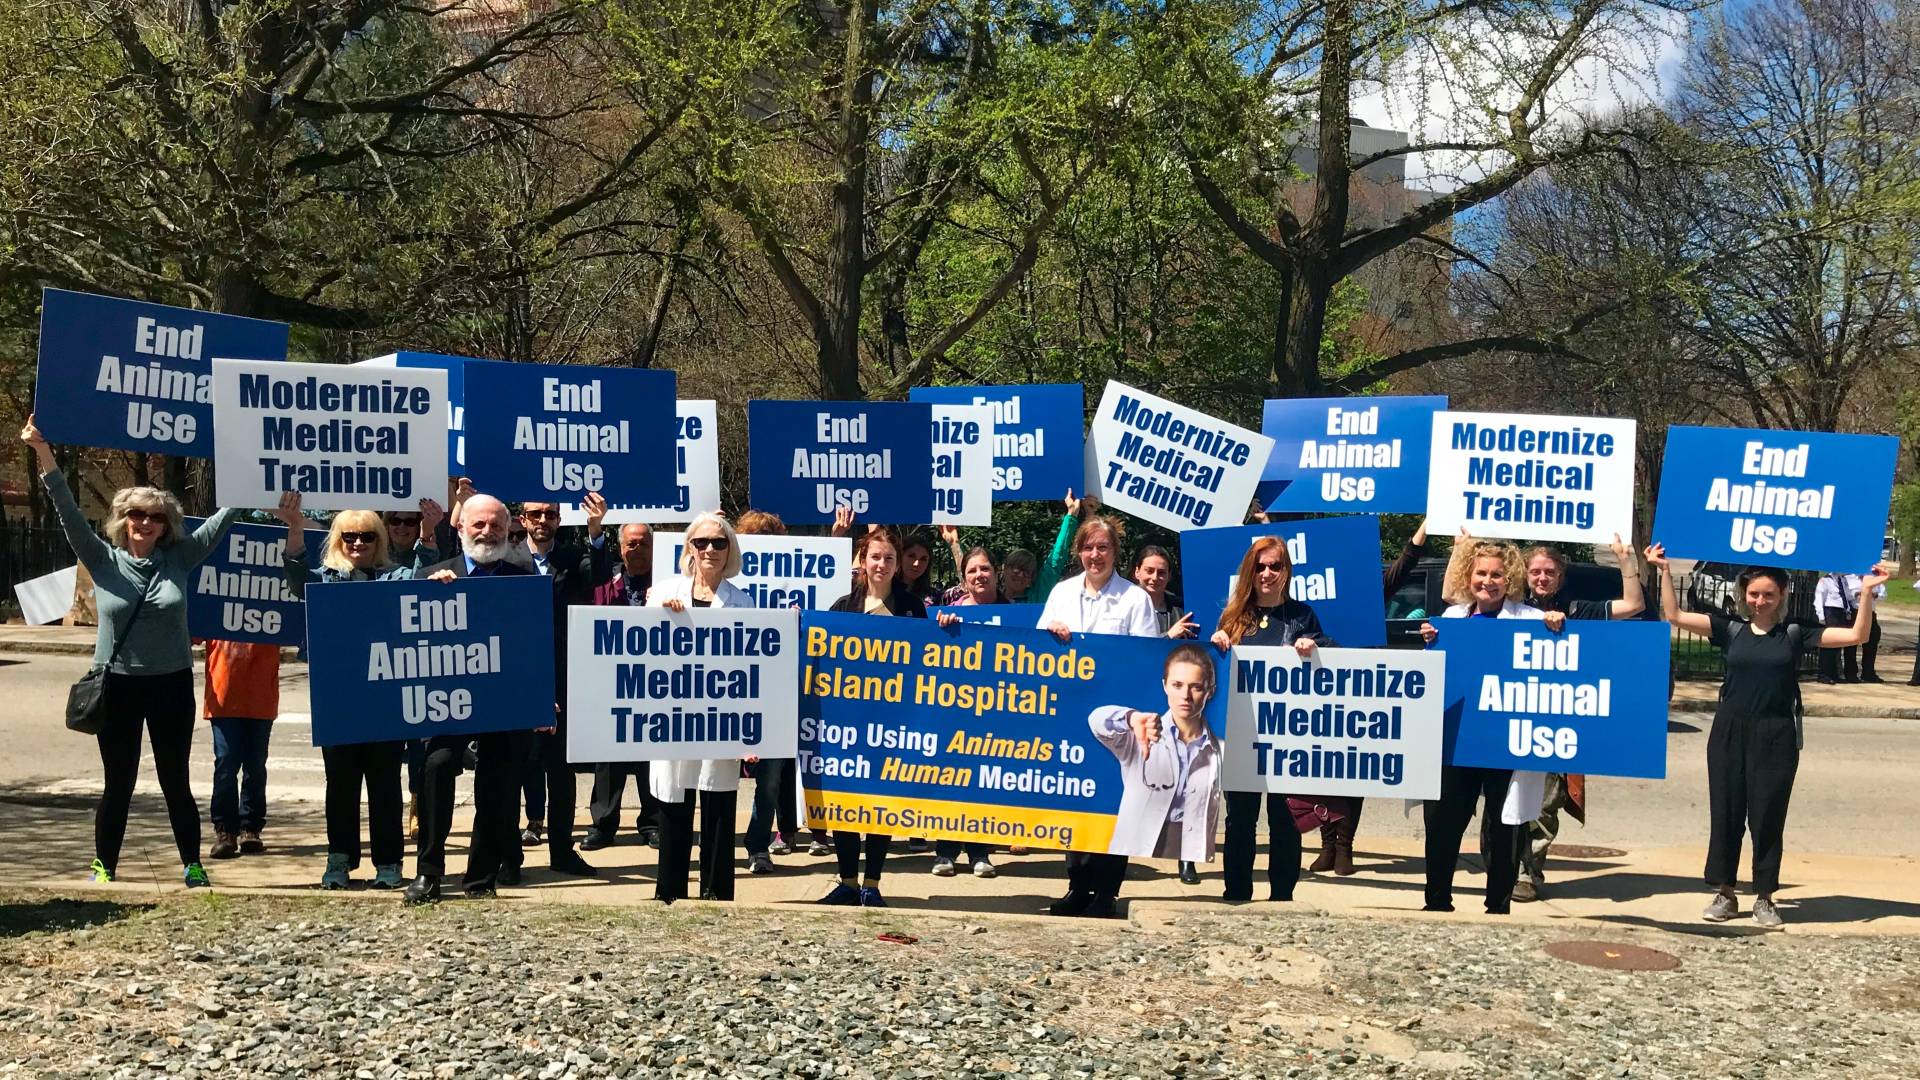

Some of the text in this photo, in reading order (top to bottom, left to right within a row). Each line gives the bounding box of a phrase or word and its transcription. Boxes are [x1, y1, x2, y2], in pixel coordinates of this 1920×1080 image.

[136, 316, 203, 361] End
[96, 355, 213, 405] Anima
[239, 373, 430, 415] Modernize
[543, 377, 601, 413] End
[126, 402, 197, 444] Use
[262, 416, 409, 455] Medical
[513, 416, 630, 454] Animal
[817, 412, 867, 443] End
[1112, 394, 1251, 467] Modernize
[1327, 406, 1379, 436] End
[1451, 422, 1614, 457] Modernize
[791, 448, 891, 479] Animal
[1115, 431, 1225, 494] Medical
[1299, 439, 1402, 469] Animal
[1742, 441, 1810, 479] End
[259, 457, 412, 499] Training
[542, 457, 604, 492] Use
[992, 466, 1023, 491] se
[1104, 460, 1213, 527] Training
[1321, 472, 1375, 502] Use
[1467, 457, 1594, 492] Medical
[816, 483, 869, 514] Use
[1463, 491, 1595, 530] Training
[1705, 477, 1835, 520] Animal
[228, 533, 287, 568] End
[1730, 518, 1798, 556] Use
[674, 544, 836, 580] ernize
[197, 565, 305, 603] Anima
[222, 601, 282, 635] Use
[400, 592, 467, 633] End
[593, 619, 781, 657] Modernize
[806, 626, 1096, 681] Brown and Rhode
[1513, 632, 1580, 671] End
[367, 635, 501, 681] Animal
[616, 663, 760, 699] Medical
[803, 664, 1058, 716] Island Hospital:
[1237, 659, 1425, 699] Modernize
[1478, 674, 1611, 717] Animal
[401, 683, 473, 725] Use
[1257, 701, 1402, 740] Medical
[611, 706, 763, 746] Training
[799, 717, 1086, 765] Stop Using Animals to
[1508, 718, 1578, 760] Use
[798, 750, 1097, 799] Teach Human Medicine
[1252, 742, 1404, 786] Training
[808, 802, 1073, 844] witchToSimulation.org
